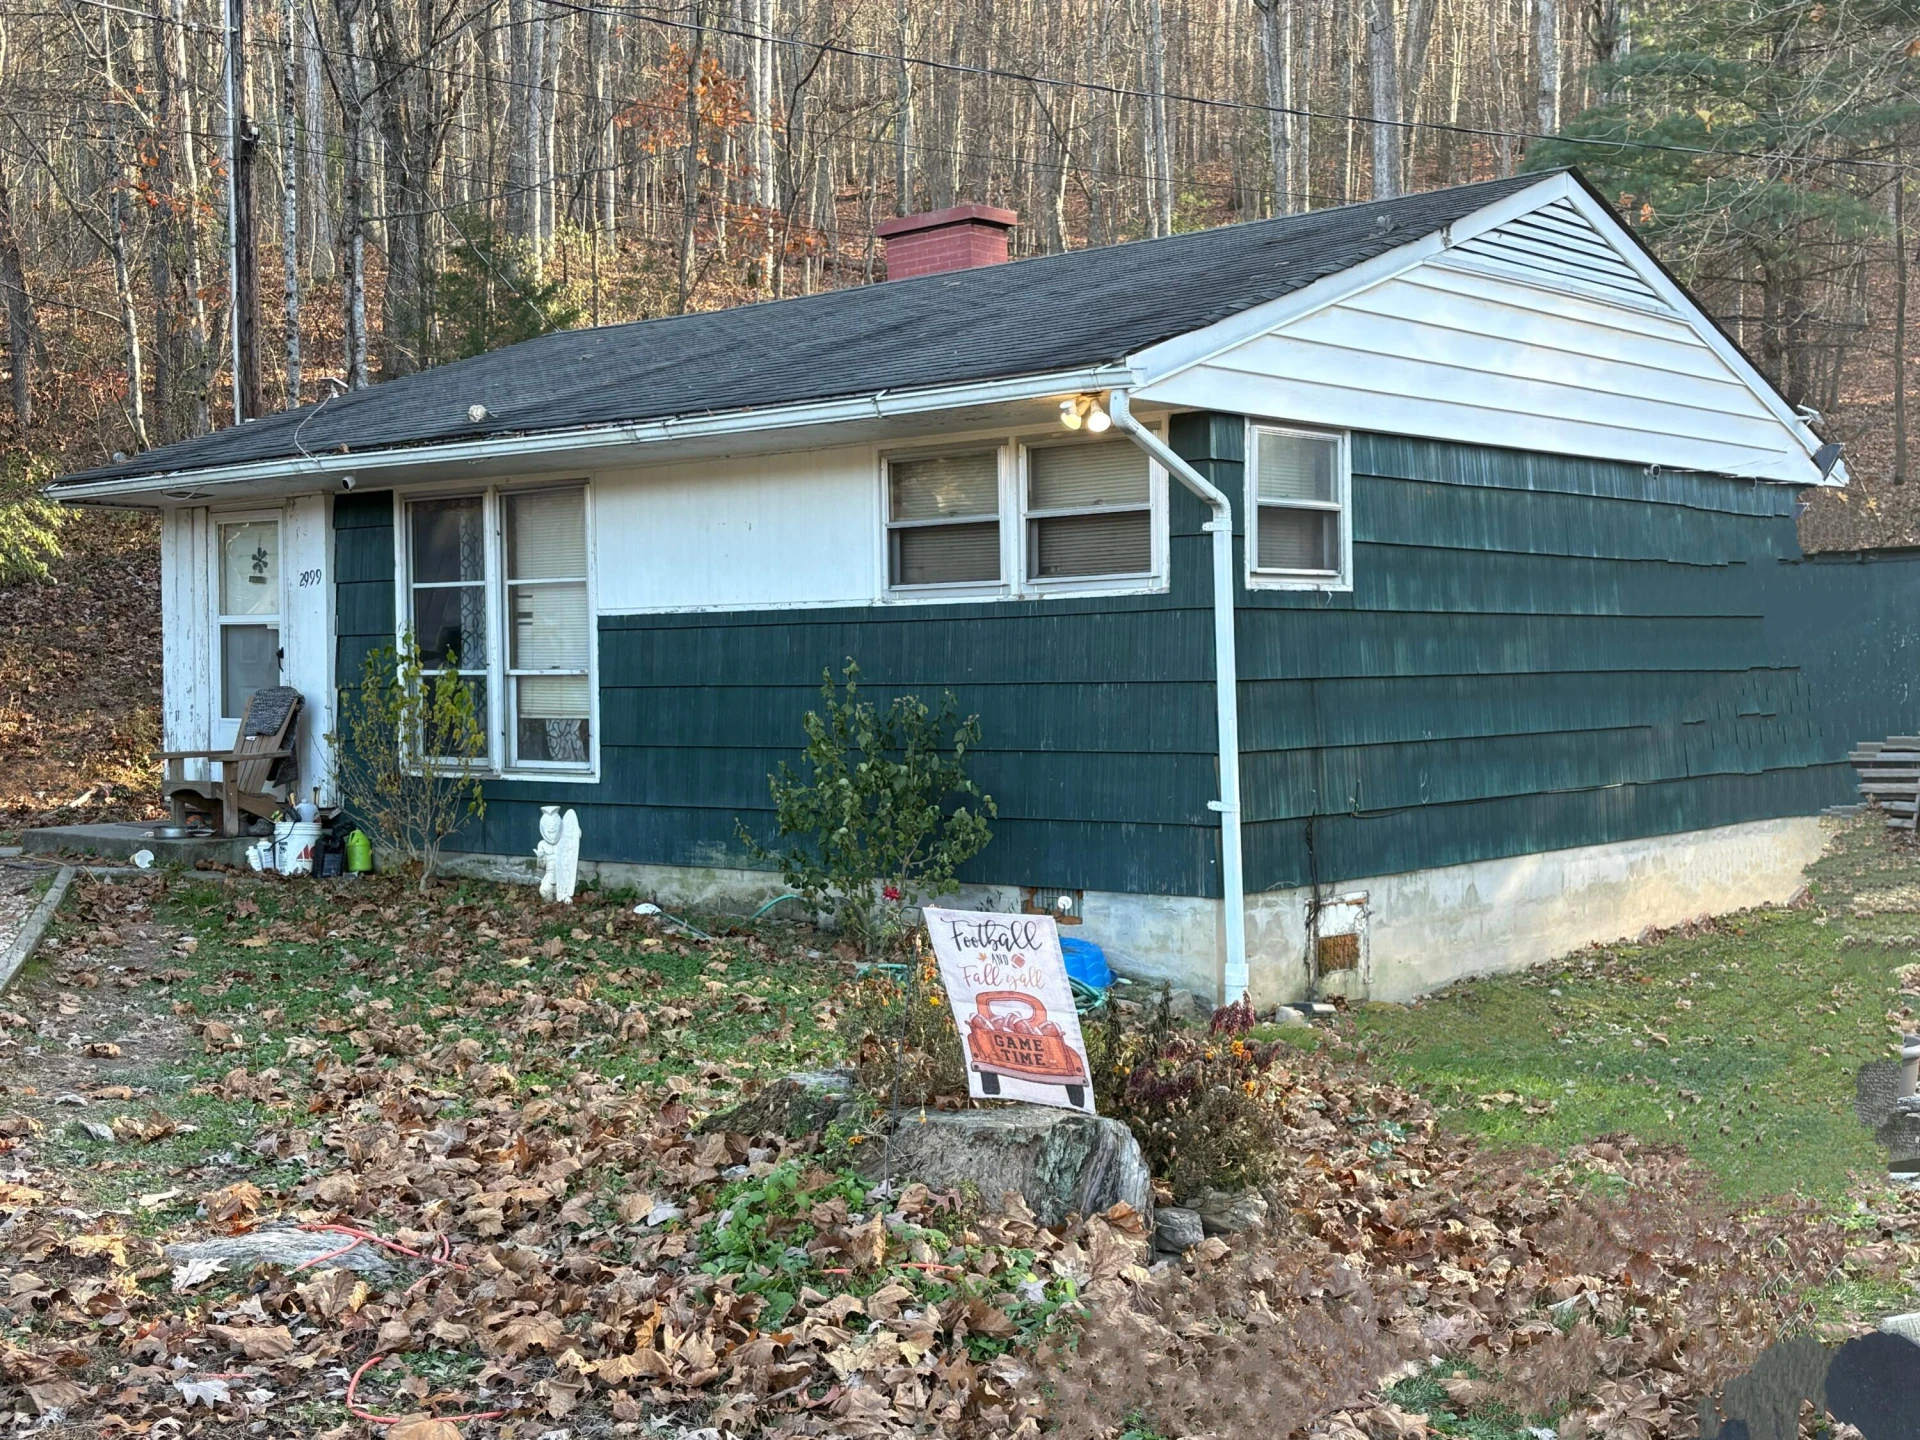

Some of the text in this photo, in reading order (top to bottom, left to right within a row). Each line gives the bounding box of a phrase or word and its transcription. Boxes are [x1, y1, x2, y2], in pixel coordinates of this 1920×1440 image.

[299, 568, 322, 588] 2999
[940, 917, 1042, 952] Football
[991, 953, 1009, 966] AND
[956, 963, 1003, 988] Fall
[994, 1034, 1044, 1052] GAME
[1000, 1049, 1046, 1066] TIME
